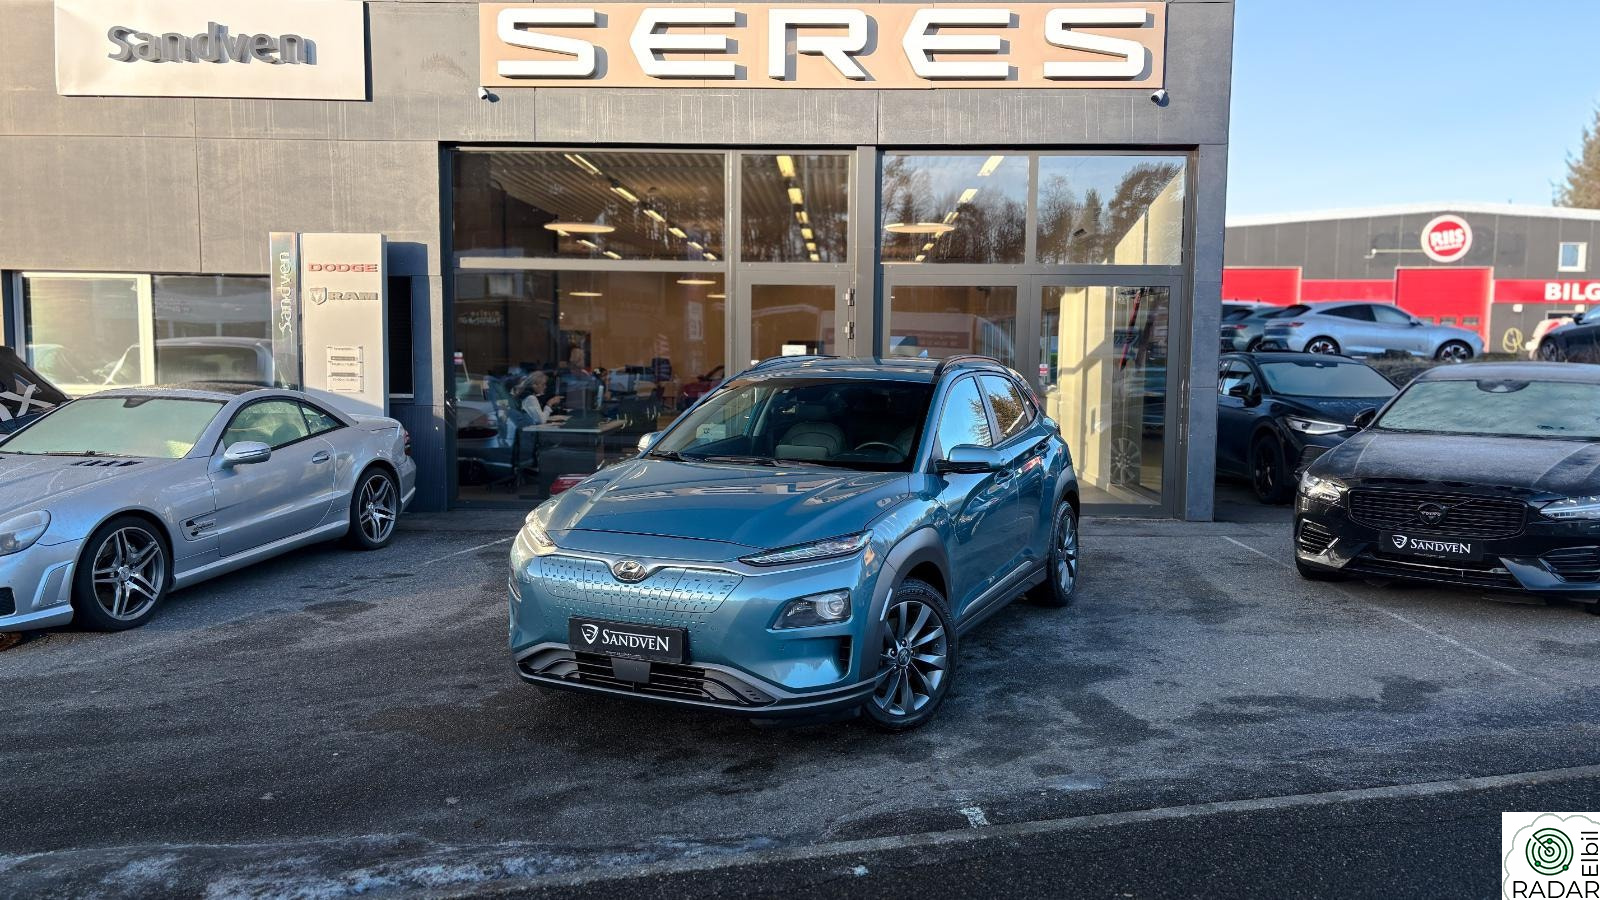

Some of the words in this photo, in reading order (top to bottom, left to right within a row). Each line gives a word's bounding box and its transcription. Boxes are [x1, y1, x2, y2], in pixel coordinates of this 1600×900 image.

[107, 21, 315, 65] Sandven
[497, 7, 1147, 80] SERES
[1430, 228, 1465, 246] RIIS
[308, 264, 378, 272] DODGE
[279, 252, 292, 333] Sandven
[328, 292, 378, 300] RAM
[602, 628, 670, 652] SANDVEN
